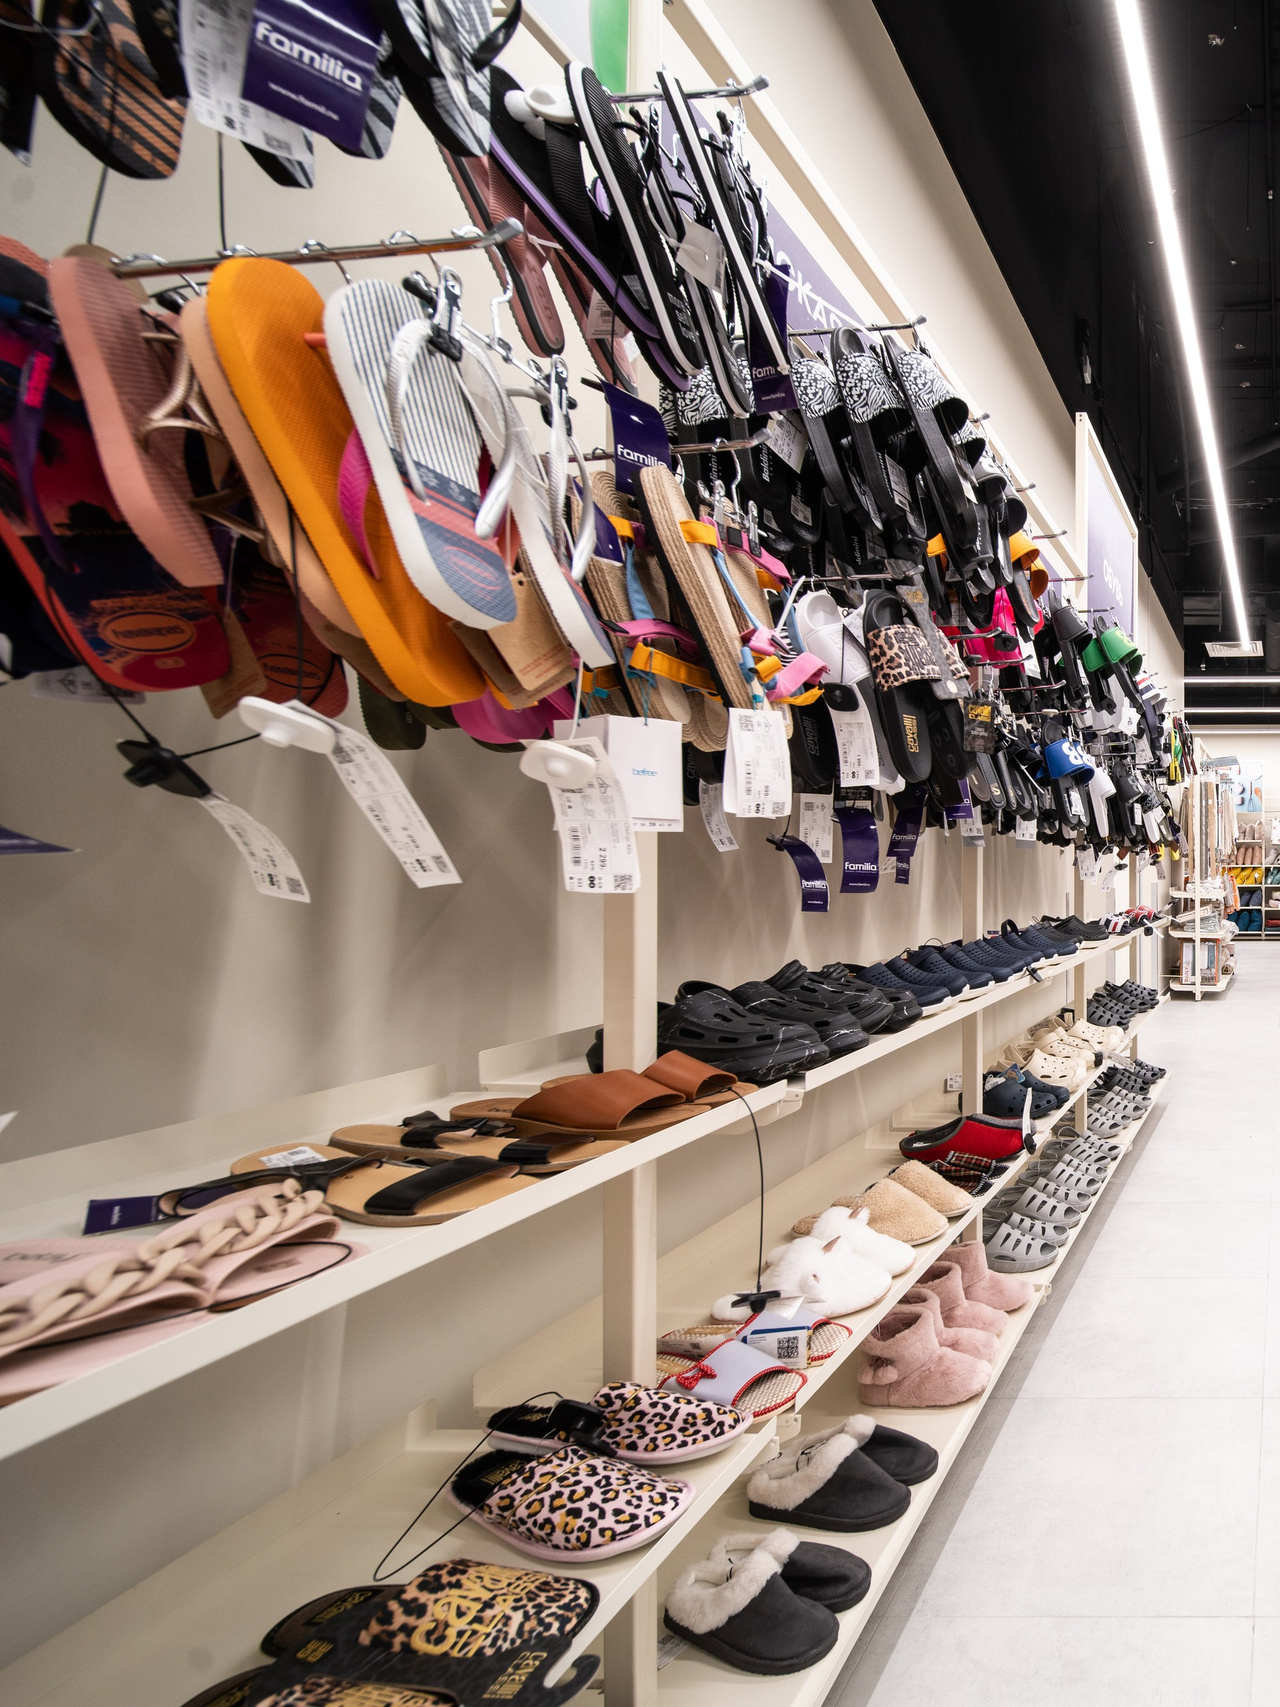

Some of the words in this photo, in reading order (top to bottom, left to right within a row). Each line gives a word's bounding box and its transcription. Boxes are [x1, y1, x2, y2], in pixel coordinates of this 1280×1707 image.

[254, 21, 363, 92] familia
[752, 365, 776, 380] fami
[1103, 558, 1124, 607] ОБУВЬ
[632, 768, 658, 777] befree
[892, 833, 917, 841] familia
[844, 861, 878, 871] familia
